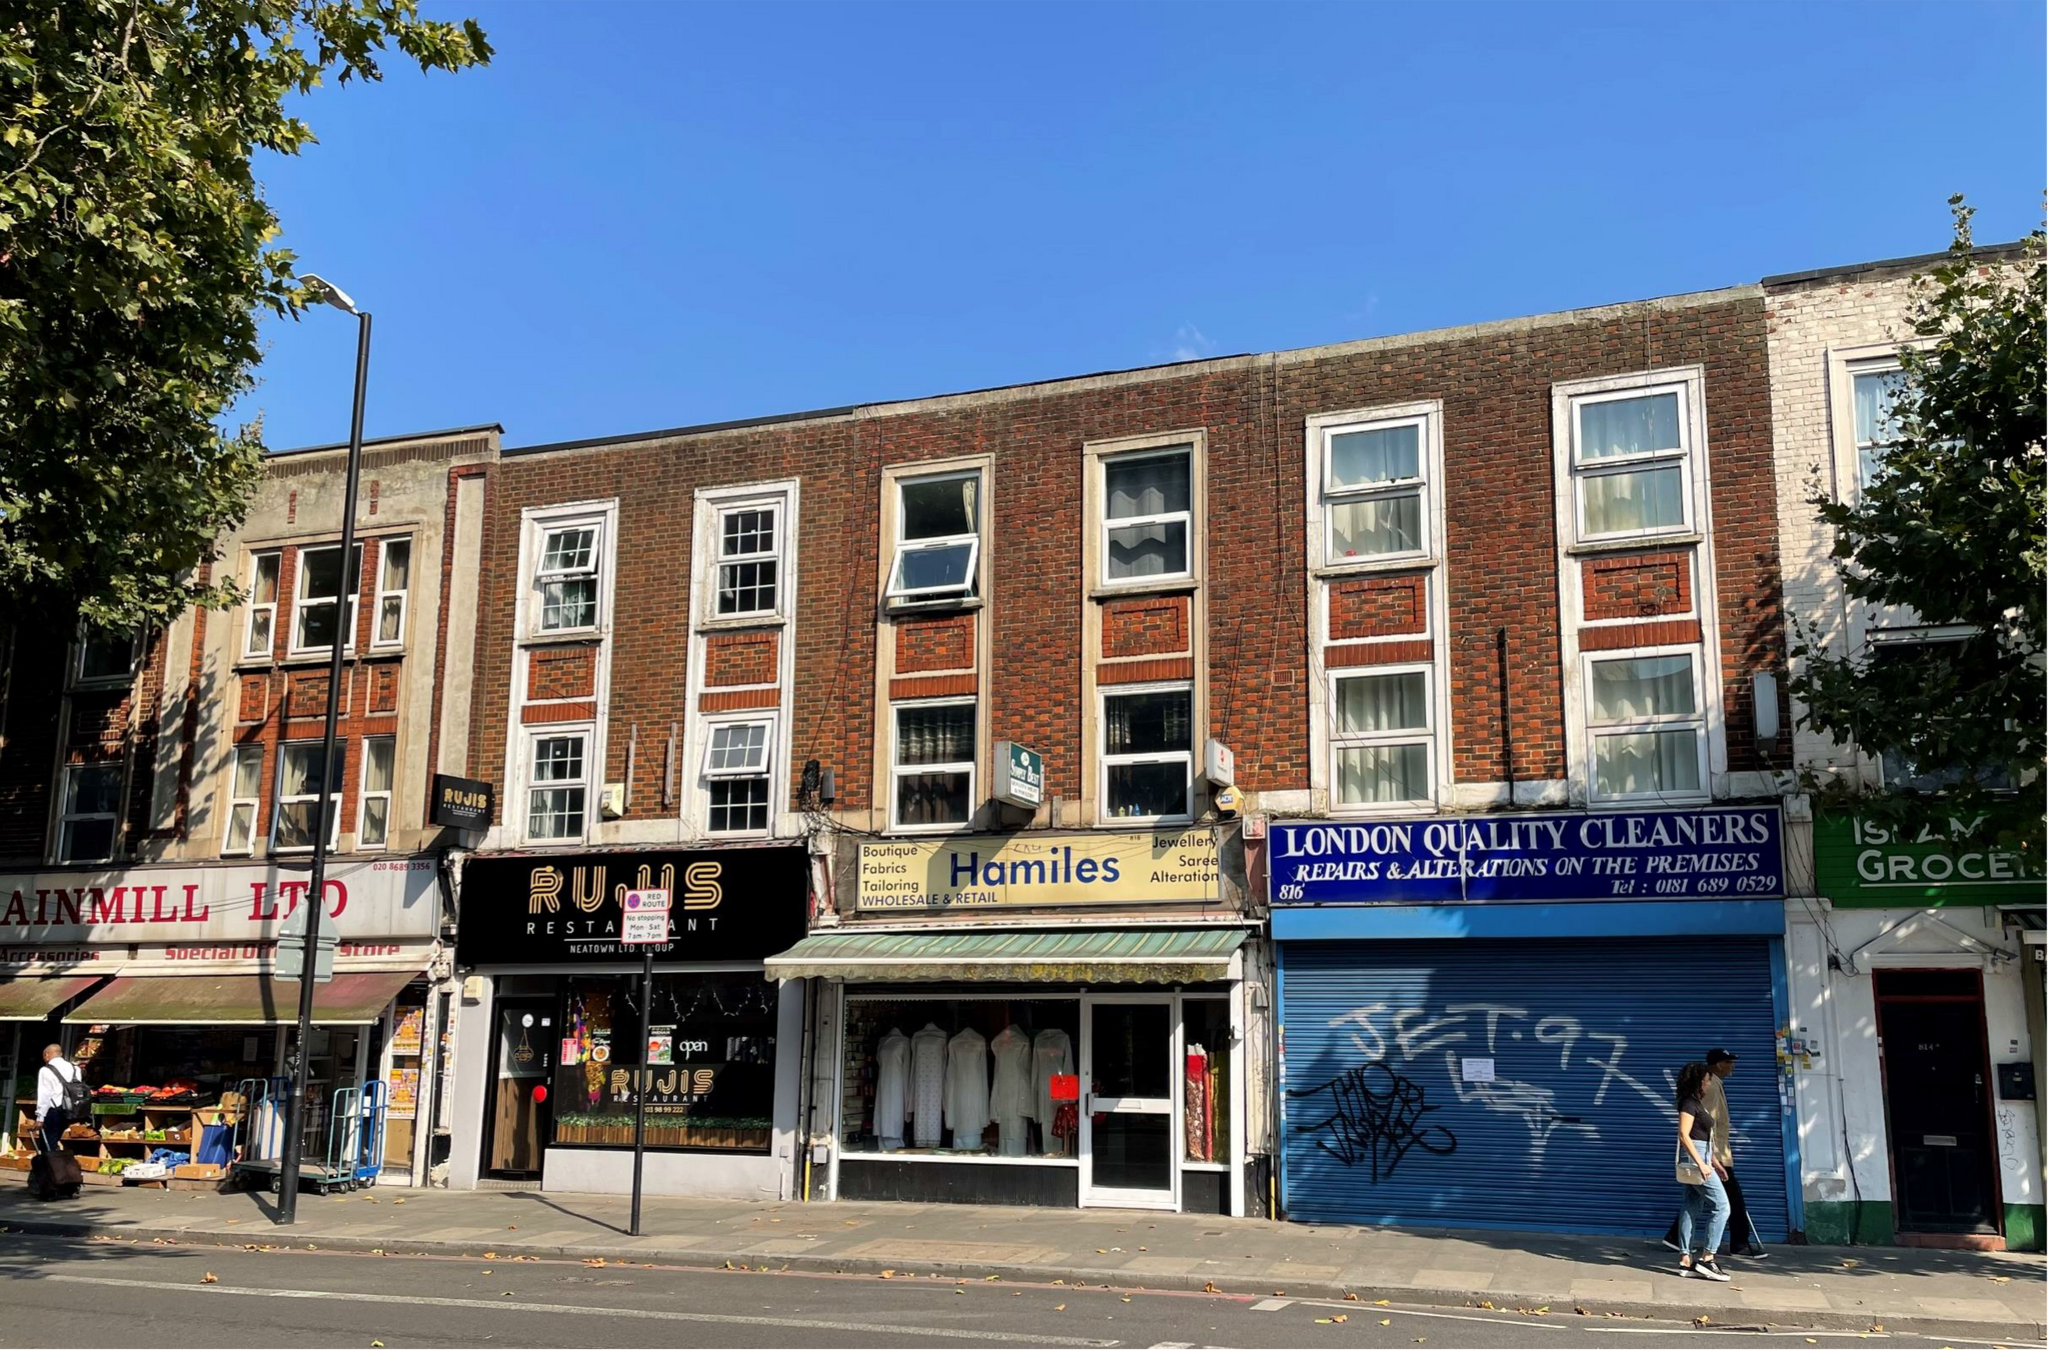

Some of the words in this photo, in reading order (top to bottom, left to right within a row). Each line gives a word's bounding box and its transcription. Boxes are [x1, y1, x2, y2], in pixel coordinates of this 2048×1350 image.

[443, 788, 487, 809] RUJIS
[1152, 834, 1218, 849] Jewellery
[1274, 824, 1413, 858] LONDON
[1423, 819, 1568, 857] QUALITY
[1579, 813, 1770, 849] CLEANERS
[863, 846, 918, 858] Boutique
[389, 863, 409, 871] 8689
[950, 845, 1120, 887] Hamiles
[1179, 855, 1219, 867] Saree
[1293, 861, 1383, 882] REPAIRS
[1406, 856, 1549, 879] ALTERATIONS
[1554, 857, 1589, 876] ON
[1592, 857, 1639, 875] THE
[1645, 853, 1761, 874] PREMISES
[863, 864, 907, 874] Fabrics
[1150, 871, 1219, 883] Alteration
[863, 880, 919, 893] Tailoring
[1279, 884, 1305, 900] 816
[1611, 880, 1635, 894] Tel
[1655, 879, 1689, 893] 0181
[1697, 878, 1729, 892] 689
[1736, 876, 1777, 892] 0529
[248, 879, 348, 921] LTD
[862, 894, 938, 906] WHOLESALE
[943, 894, 951, 904] &
[957, 892, 998, 903] RETAIL
[0, 950, 100, 962] Accessories
[165, 945, 236, 961] Special
[339, 941, 400, 956] Store
[570, 944, 615, 954] NEATOWN
[679, 1040, 708, 1061] open
[610, 1069, 714, 1095] RUJIS
